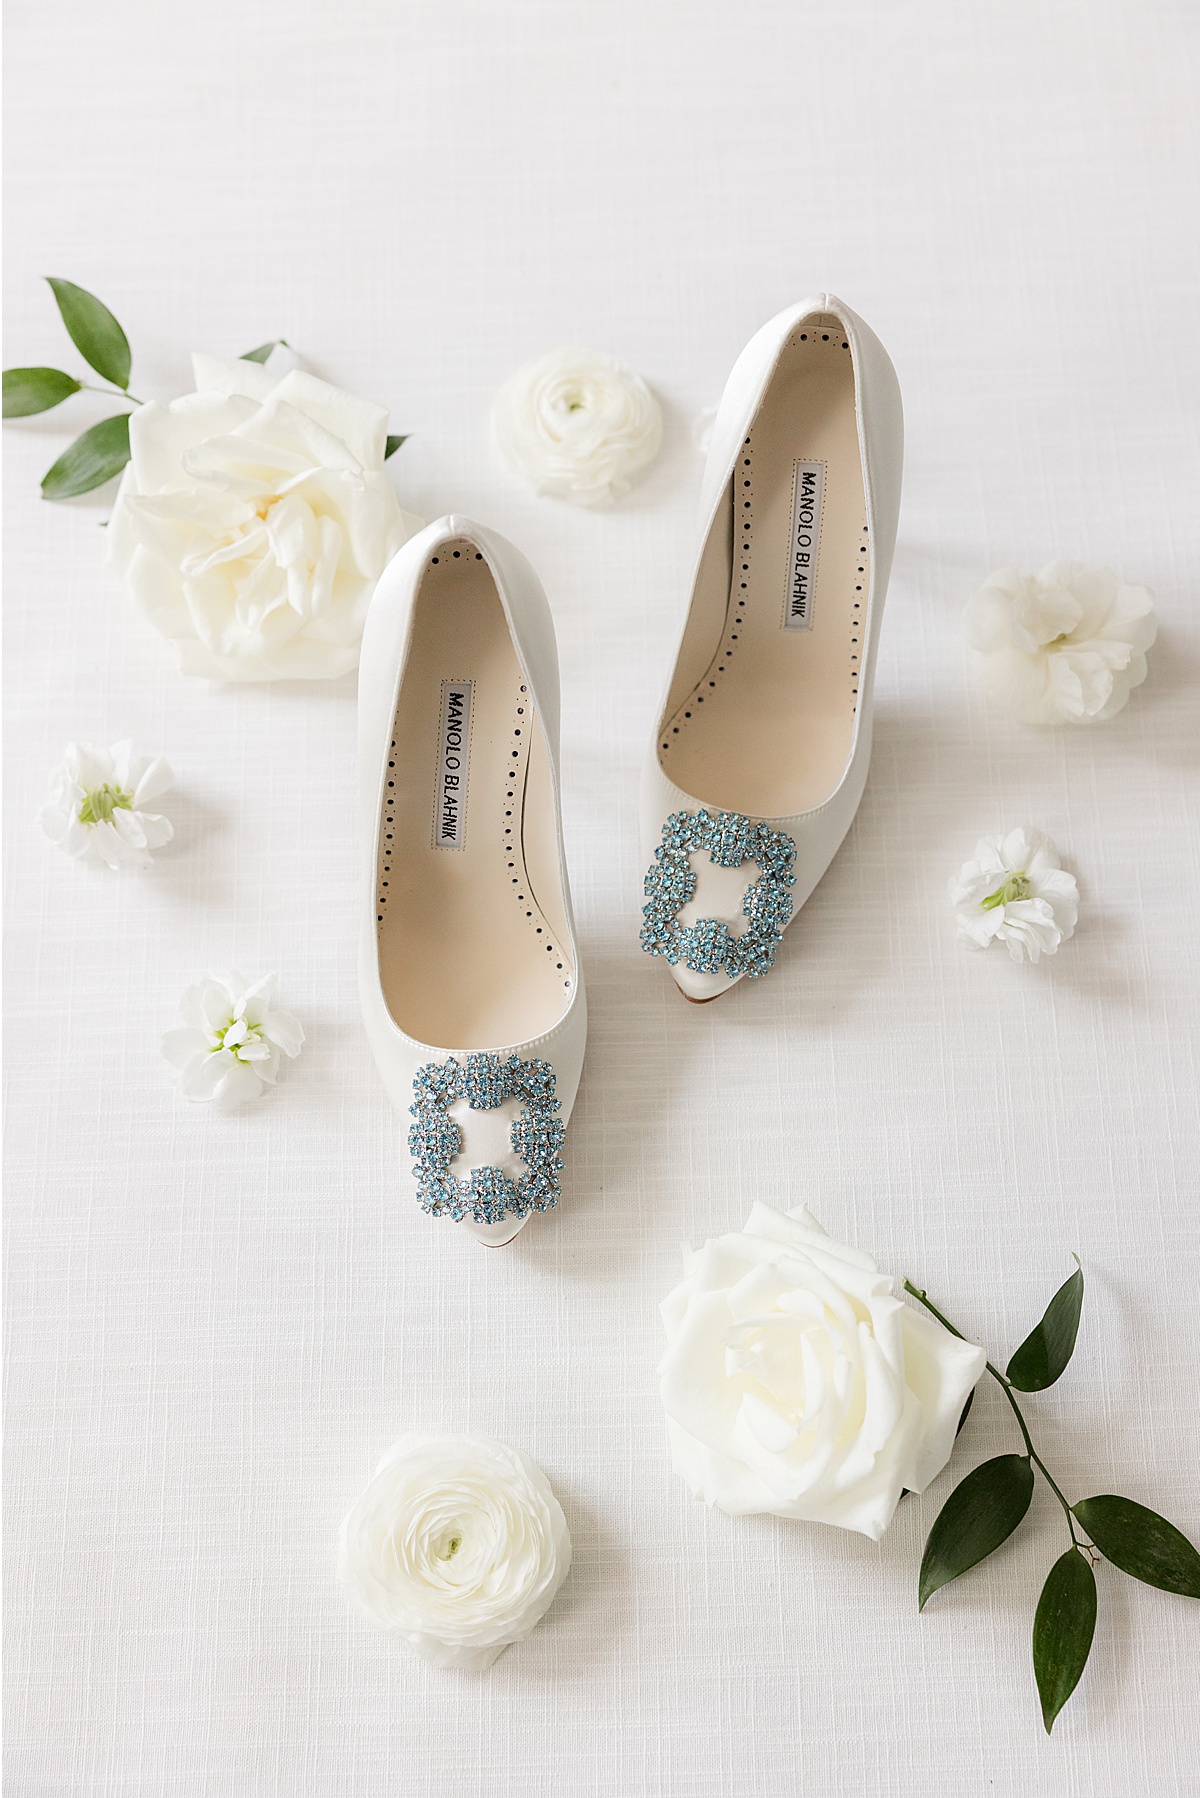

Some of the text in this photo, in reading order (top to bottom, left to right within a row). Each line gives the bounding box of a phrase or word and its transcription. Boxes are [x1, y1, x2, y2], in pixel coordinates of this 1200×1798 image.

[791, 472, 817, 618] MANOLO BLAHNIK
[441, 692, 465, 841] MANOLO BLAHNIK
